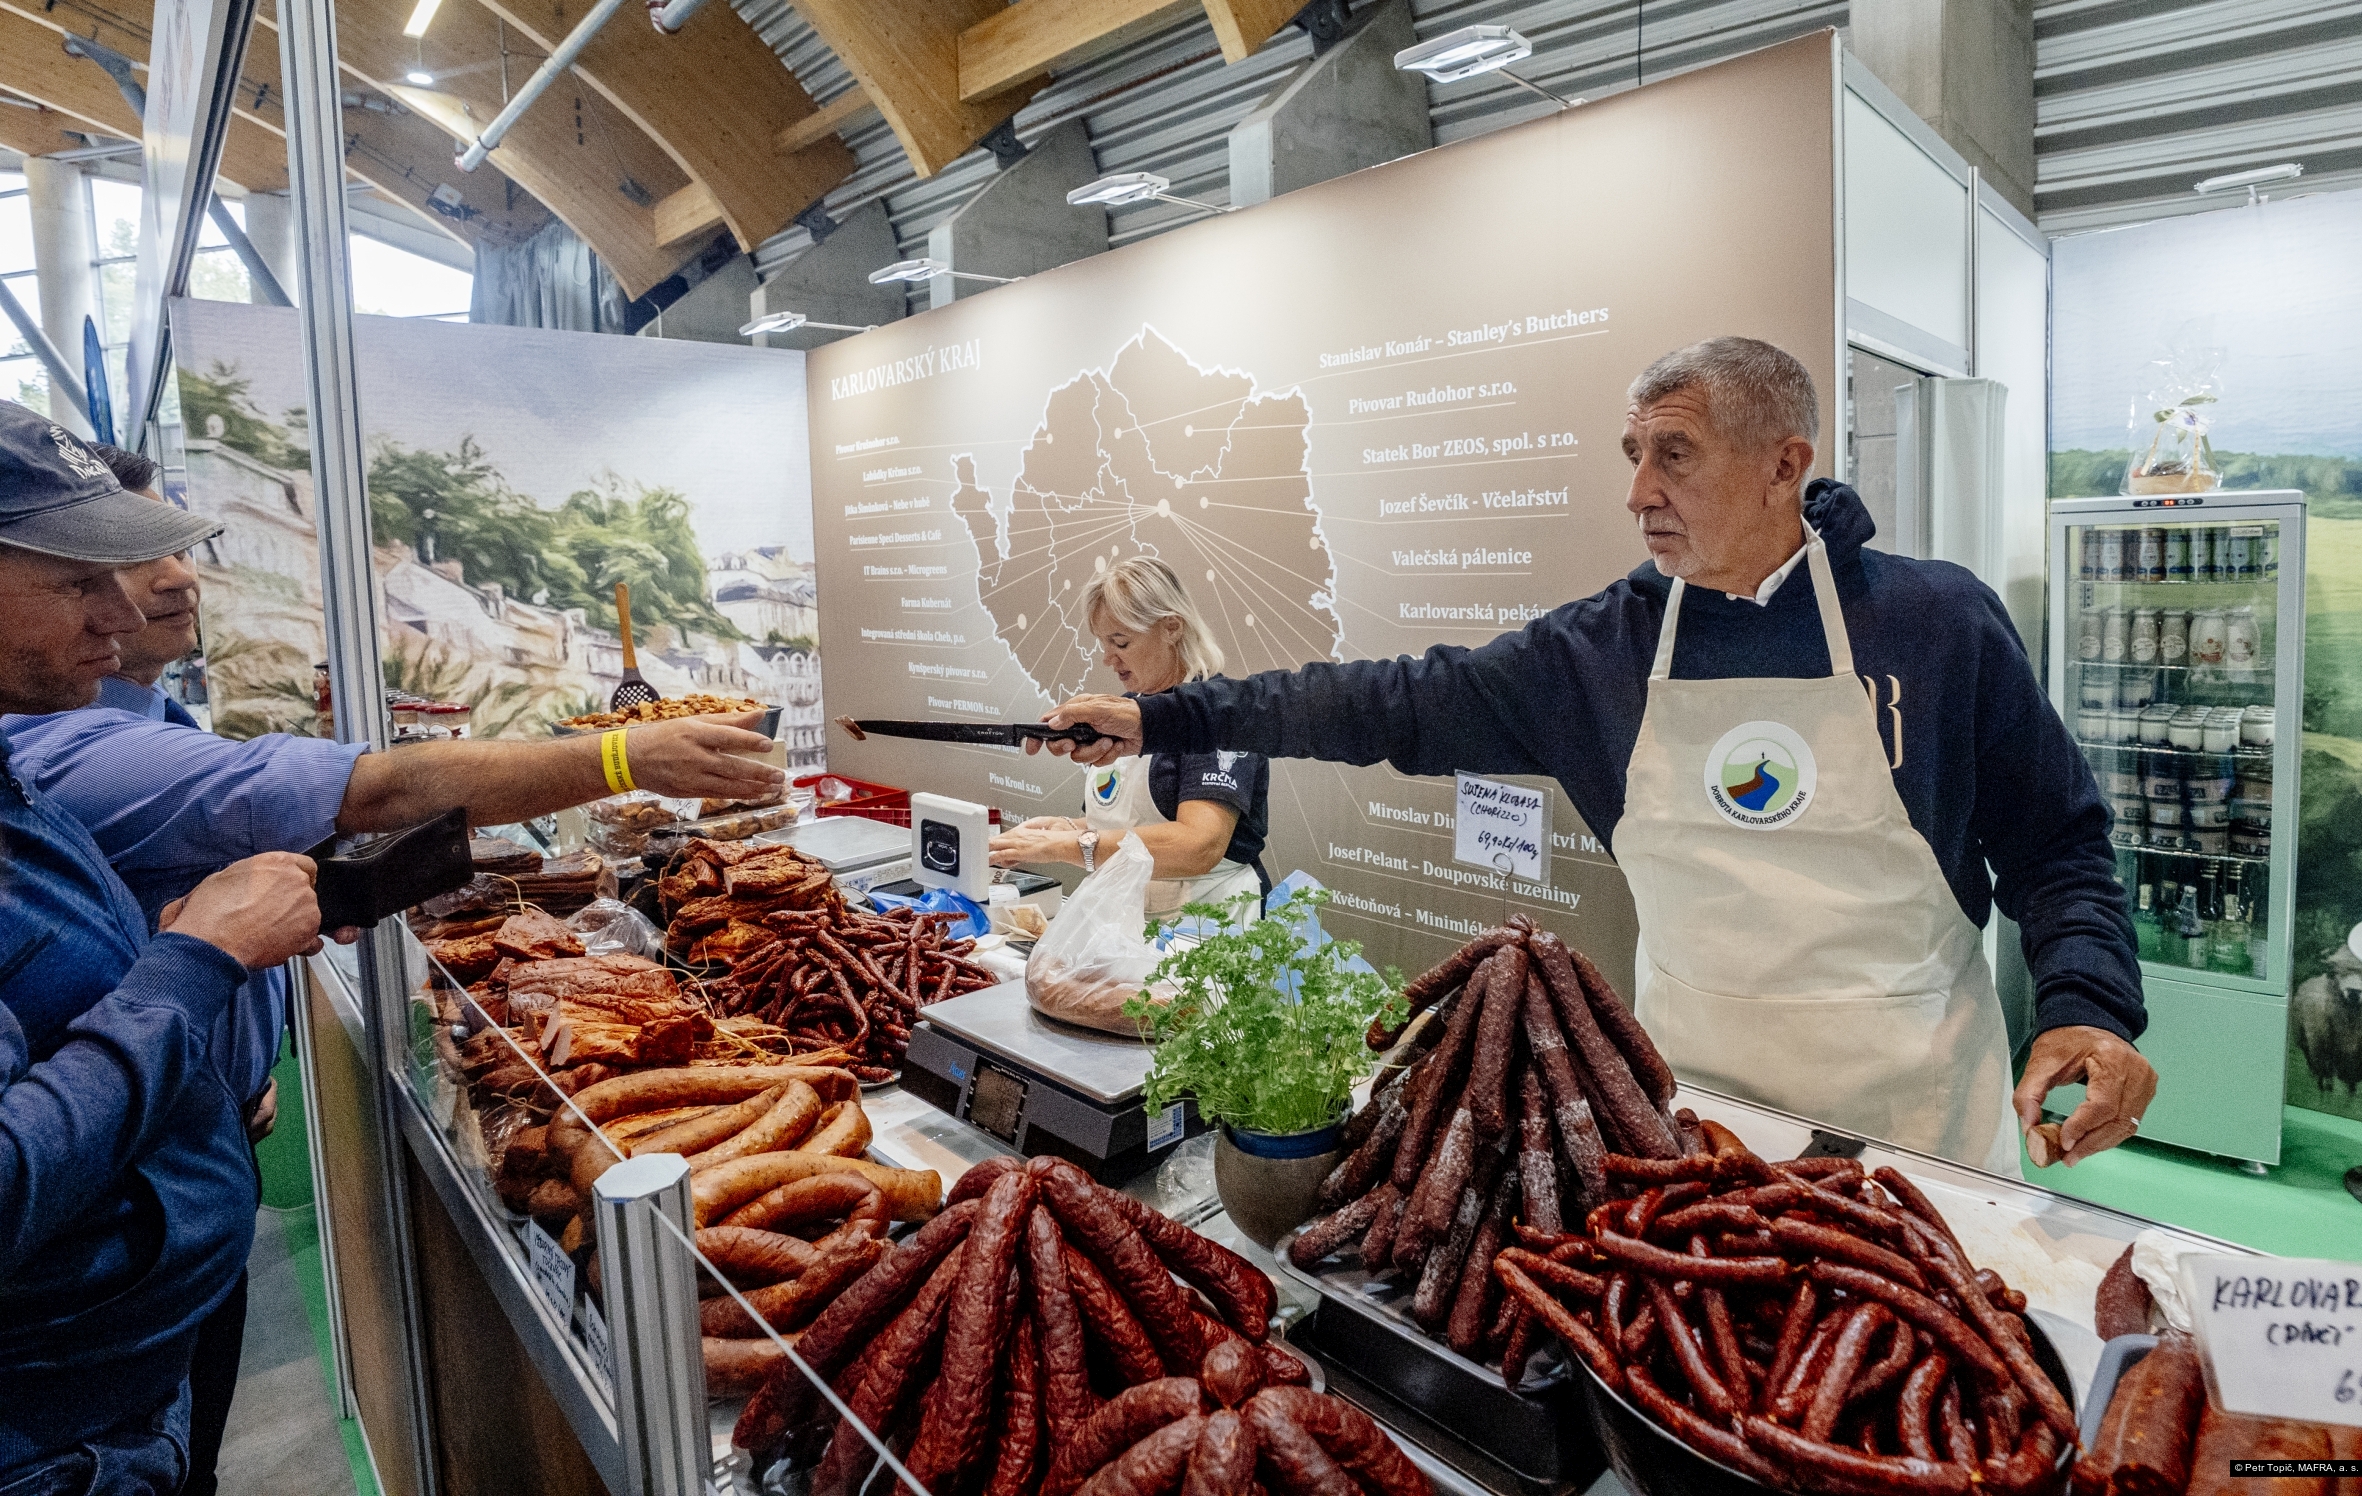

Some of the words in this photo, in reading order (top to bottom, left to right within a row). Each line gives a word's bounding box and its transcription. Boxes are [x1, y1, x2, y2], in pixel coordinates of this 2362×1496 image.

[1319, 344, 1382, 368] Stanislav
[1385, 334, 1432, 358] Konár
[1526, 306, 1609, 334] Butchers
[830, 345, 935, 401] KARLOVARSKÝ
[939, 338, 981, 374] KRAJ
[1349, 395, 1403, 414] Pivovar
[1406, 384, 1475, 406] Rudohor
[1478, 381, 1517, 398] s.r.o.
[1362, 444, 1409, 464] Statek
[1412, 441, 1441, 460] Bor
[1443, 437, 1489, 458] ZEOS,
[1492, 432, 1533, 457] spol.
[1537, 435, 1546, 448] s
[1550, 430, 1579, 447] r.o.
[908, 466, 922, 476] s.r.o.
[1379, 496, 1418, 518] Jozef
[1419, 492, 1469, 512] Ševčík
[1482, 486, 1569, 510] Včelařství
[894, 532, 921, 543] Desserts
[921, 530, 927, 542] &
[927, 529, 942, 541] Café
[1391, 546, 1458, 567] Valečská
[1461, 546, 1533, 569] pálenice
[863, 565, 870, 576] IT
[870, 565, 890, 576] Brains
[889, 567, 903, 575] s.r.o.
[908, 564, 948, 578] Microgreens
[901, 596, 920, 608] Farma
[921, 596, 952, 609] Kubernát
[1399, 600, 1494, 621] Karlovarská
[1498, 603, 1553, 625] pekár
[861, 627, 895, 641] Integrovaná
[894, 629, 917, 641] střední
[916, 629, 934, 642] škola
[934, 631, 953, 644] Cheb,
[953, 634, 966, 646] p.o.
[908, 661, 945, 678] Kynšperský
[945, 665, 971, 678] pivovar
[971, 670, 988, 679] s.r.o.
[928, 695, 953, 709] Pivovar
[953, 699, 984, 713] PERMON
[984, 705, 1001, 716] s.r.o.
[989, 772, 1005, 786] Pivo
[1025, 783, 1043, 795] s.r.o.
[1202, 771, 1238, 789] KRČMA
[1368, 802, 1430, 826] Miroslav
[1711, 785, 1732, 815] DOBROTA
[1731, 808, 1792, 825] KARLOVARSKÉHO
[1792, 790, 1807, 812] KRAJE
[1328, 842, 1362, 863] Josef
[1364, 848, 1409, 871] Pelant
[1423, 860, 1508, 892] Doupovské
[1513, 880, 1582, 909] uzeniny
[1332, 889, 1401, 919] Květoňová
[1415, 909, 1496, 938] Minimlék
